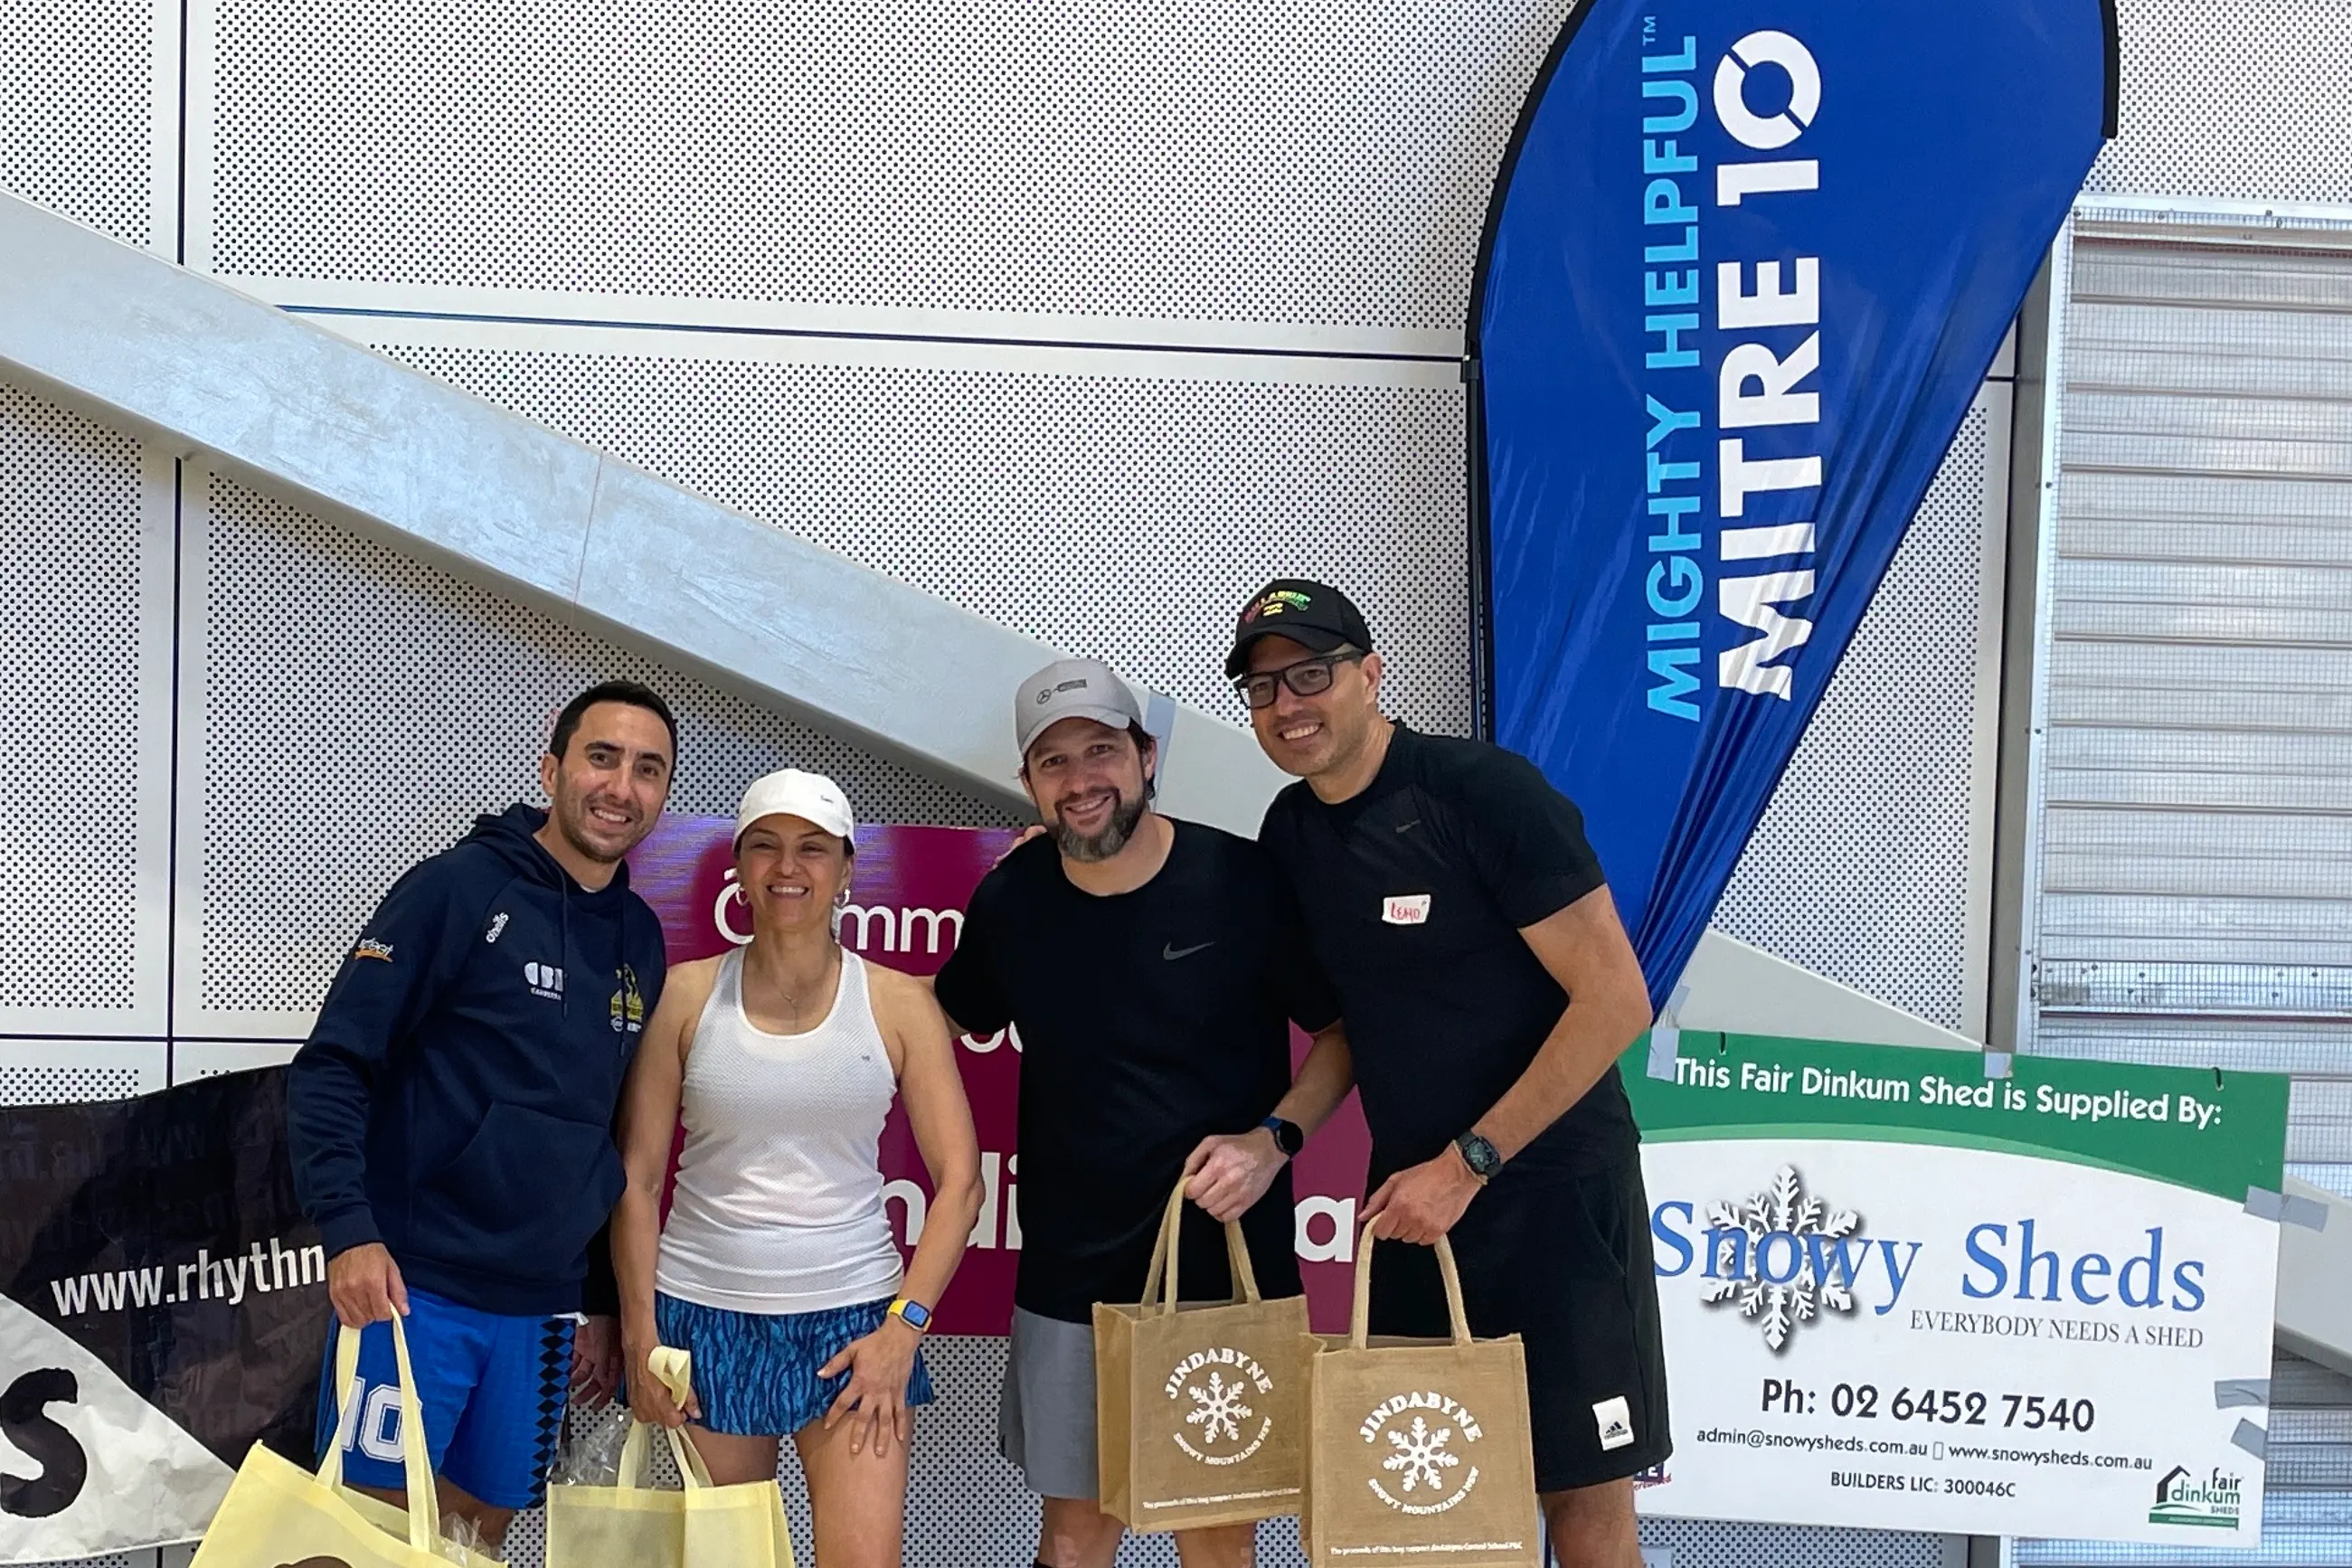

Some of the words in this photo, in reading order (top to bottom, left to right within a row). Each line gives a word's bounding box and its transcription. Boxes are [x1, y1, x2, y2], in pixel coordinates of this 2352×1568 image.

[1714, 30, 1821, 206] 10
[1642, 35, 1700, 369] HELPFUL
[1717, 256, 1823, 702] MITRE
[1647, 394, 1704, 723] MIGHTY
[1675, 1057, 1731, 1088] This
[1741, 1063, 1793, 1093] Fair
[1801, 1067, 1910, 1102] Dinkum
[1919, 1075, 1994, 1109] Shed
[2003, 1082, 2027, 1111] is
[2036, 1085, 2170, 1122] Supplied
[2177, 1095, 2222, 1130] By:
[1651, 1201, 1923, 1317] Snowy
[1961, 1218, 2206, 1312] Sheds
[1910, 1309, 2045, 1338] EVERYBODY
[2047, 1318, 2121, 1344] NEEDS
[2124, 1325, 2140, 1345] A
[2144, 1326, 2204, 1349] SHED
[1165, 1347, 1273, 1400] JINDABYNE
[1359, 1391, 1483, 1443] JINDABYNE
[1761, 1378, 1817, 1415] Ph:
[1830, 1383, 1879, 1419] 02
[1891, 1386, 1988, 1426] 6452
[2001, 1394, 2095, 1432] 7540
[1696, 1427, 1928, 1456] admin@snowysheds.com.au
[1948, 1445, 2153, 1470] www.snowysheds.com.au
[1830, 1470, 1905, 1491] BUILDERS
[1910, 1477, 1939, 1493] LIC:
[1943, 1478, 2017, 1497] 300046C
[2171, 1478, 2241, 1505] dinkum
[2212, 1467, 2243, 1490] fair
